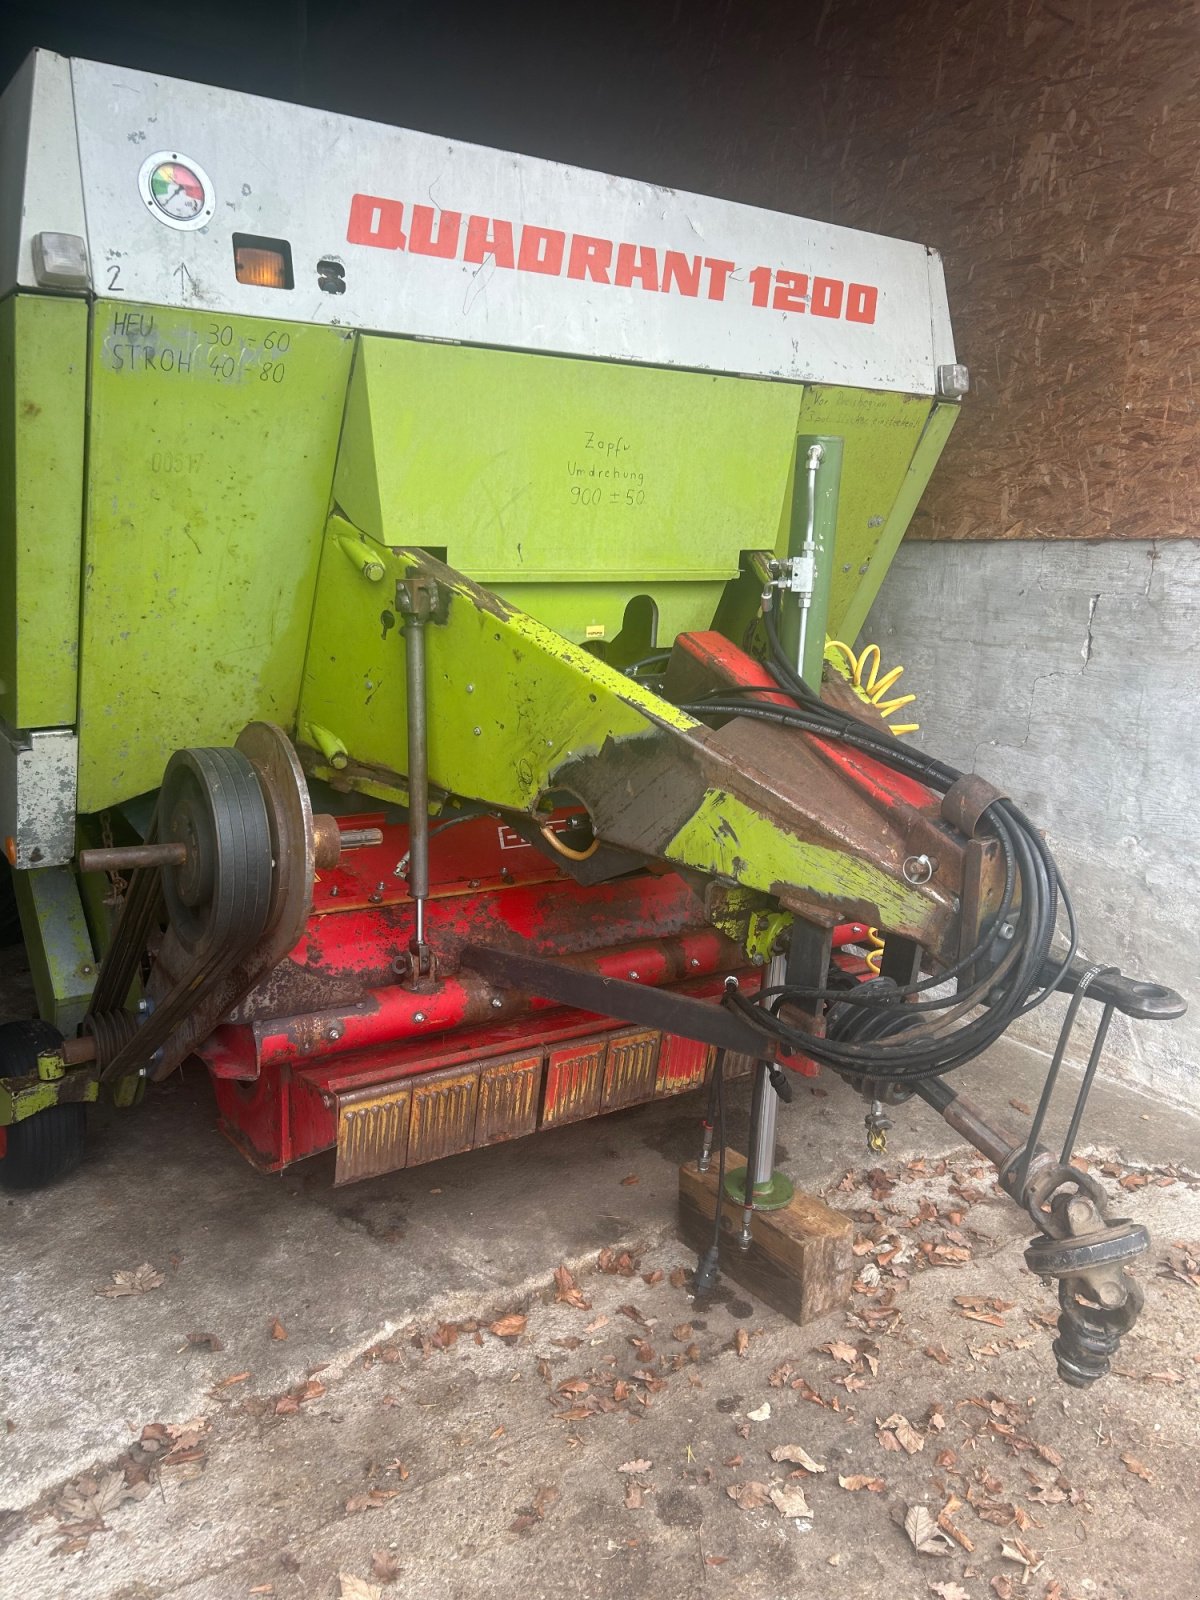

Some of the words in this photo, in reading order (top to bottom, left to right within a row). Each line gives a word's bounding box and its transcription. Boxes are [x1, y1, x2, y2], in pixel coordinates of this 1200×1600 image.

[106, 265, 125, 292] 2
[346, 193, 736, 302] QUADRANT
[749, 266, 879, 325] 1200
[113, 311, 155, 337] HEU
[207, 323, 234, 348] 30
[263, 330, 291, 353] 60
[111, 343, 192, 374] STROH
[209, 355, 236, 379] 40
[259, 361, 285, 384] 80
[570, 486, 602, 506] 900
[626, 488, 645, 506] 50
